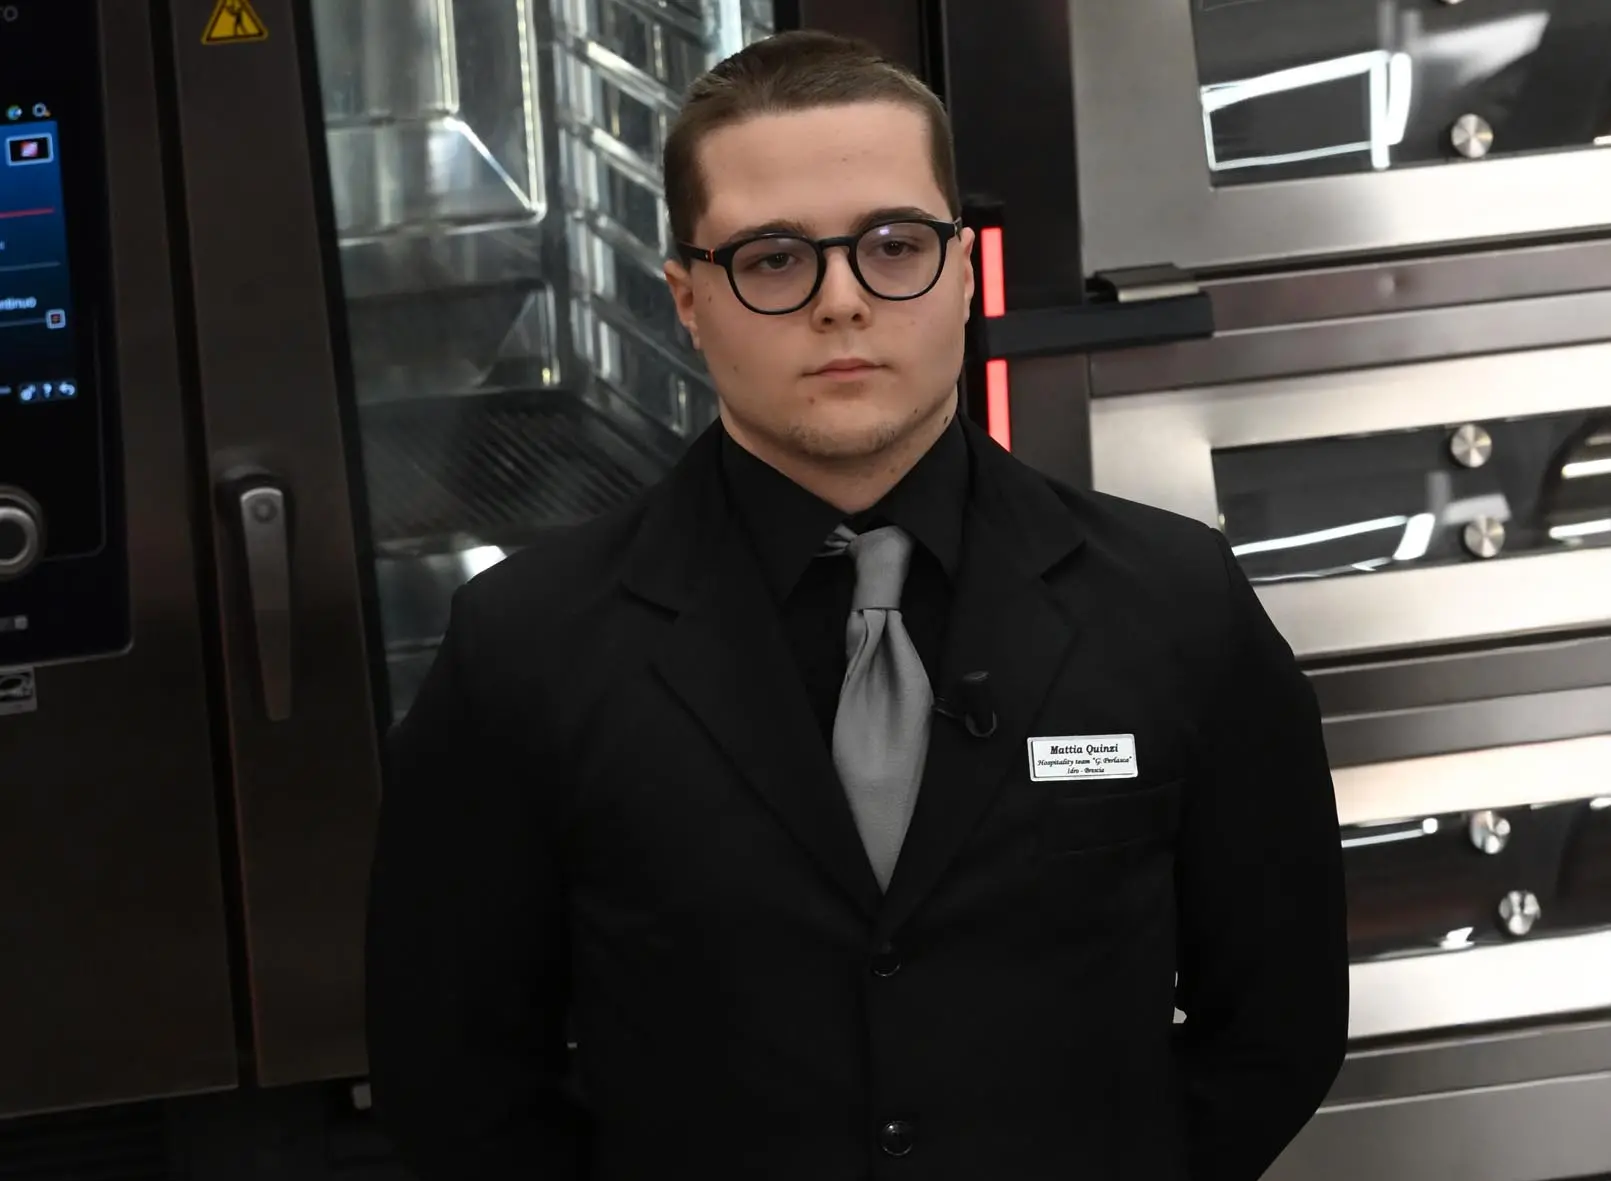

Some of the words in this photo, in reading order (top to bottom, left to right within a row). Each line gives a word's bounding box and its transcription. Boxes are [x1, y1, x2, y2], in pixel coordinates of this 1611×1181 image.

[1050, 745, 1083, 755] Mattia
[1086, 743, 1119, 755] Quinzi
[1037, 758, 1074, 767] Hospitality
